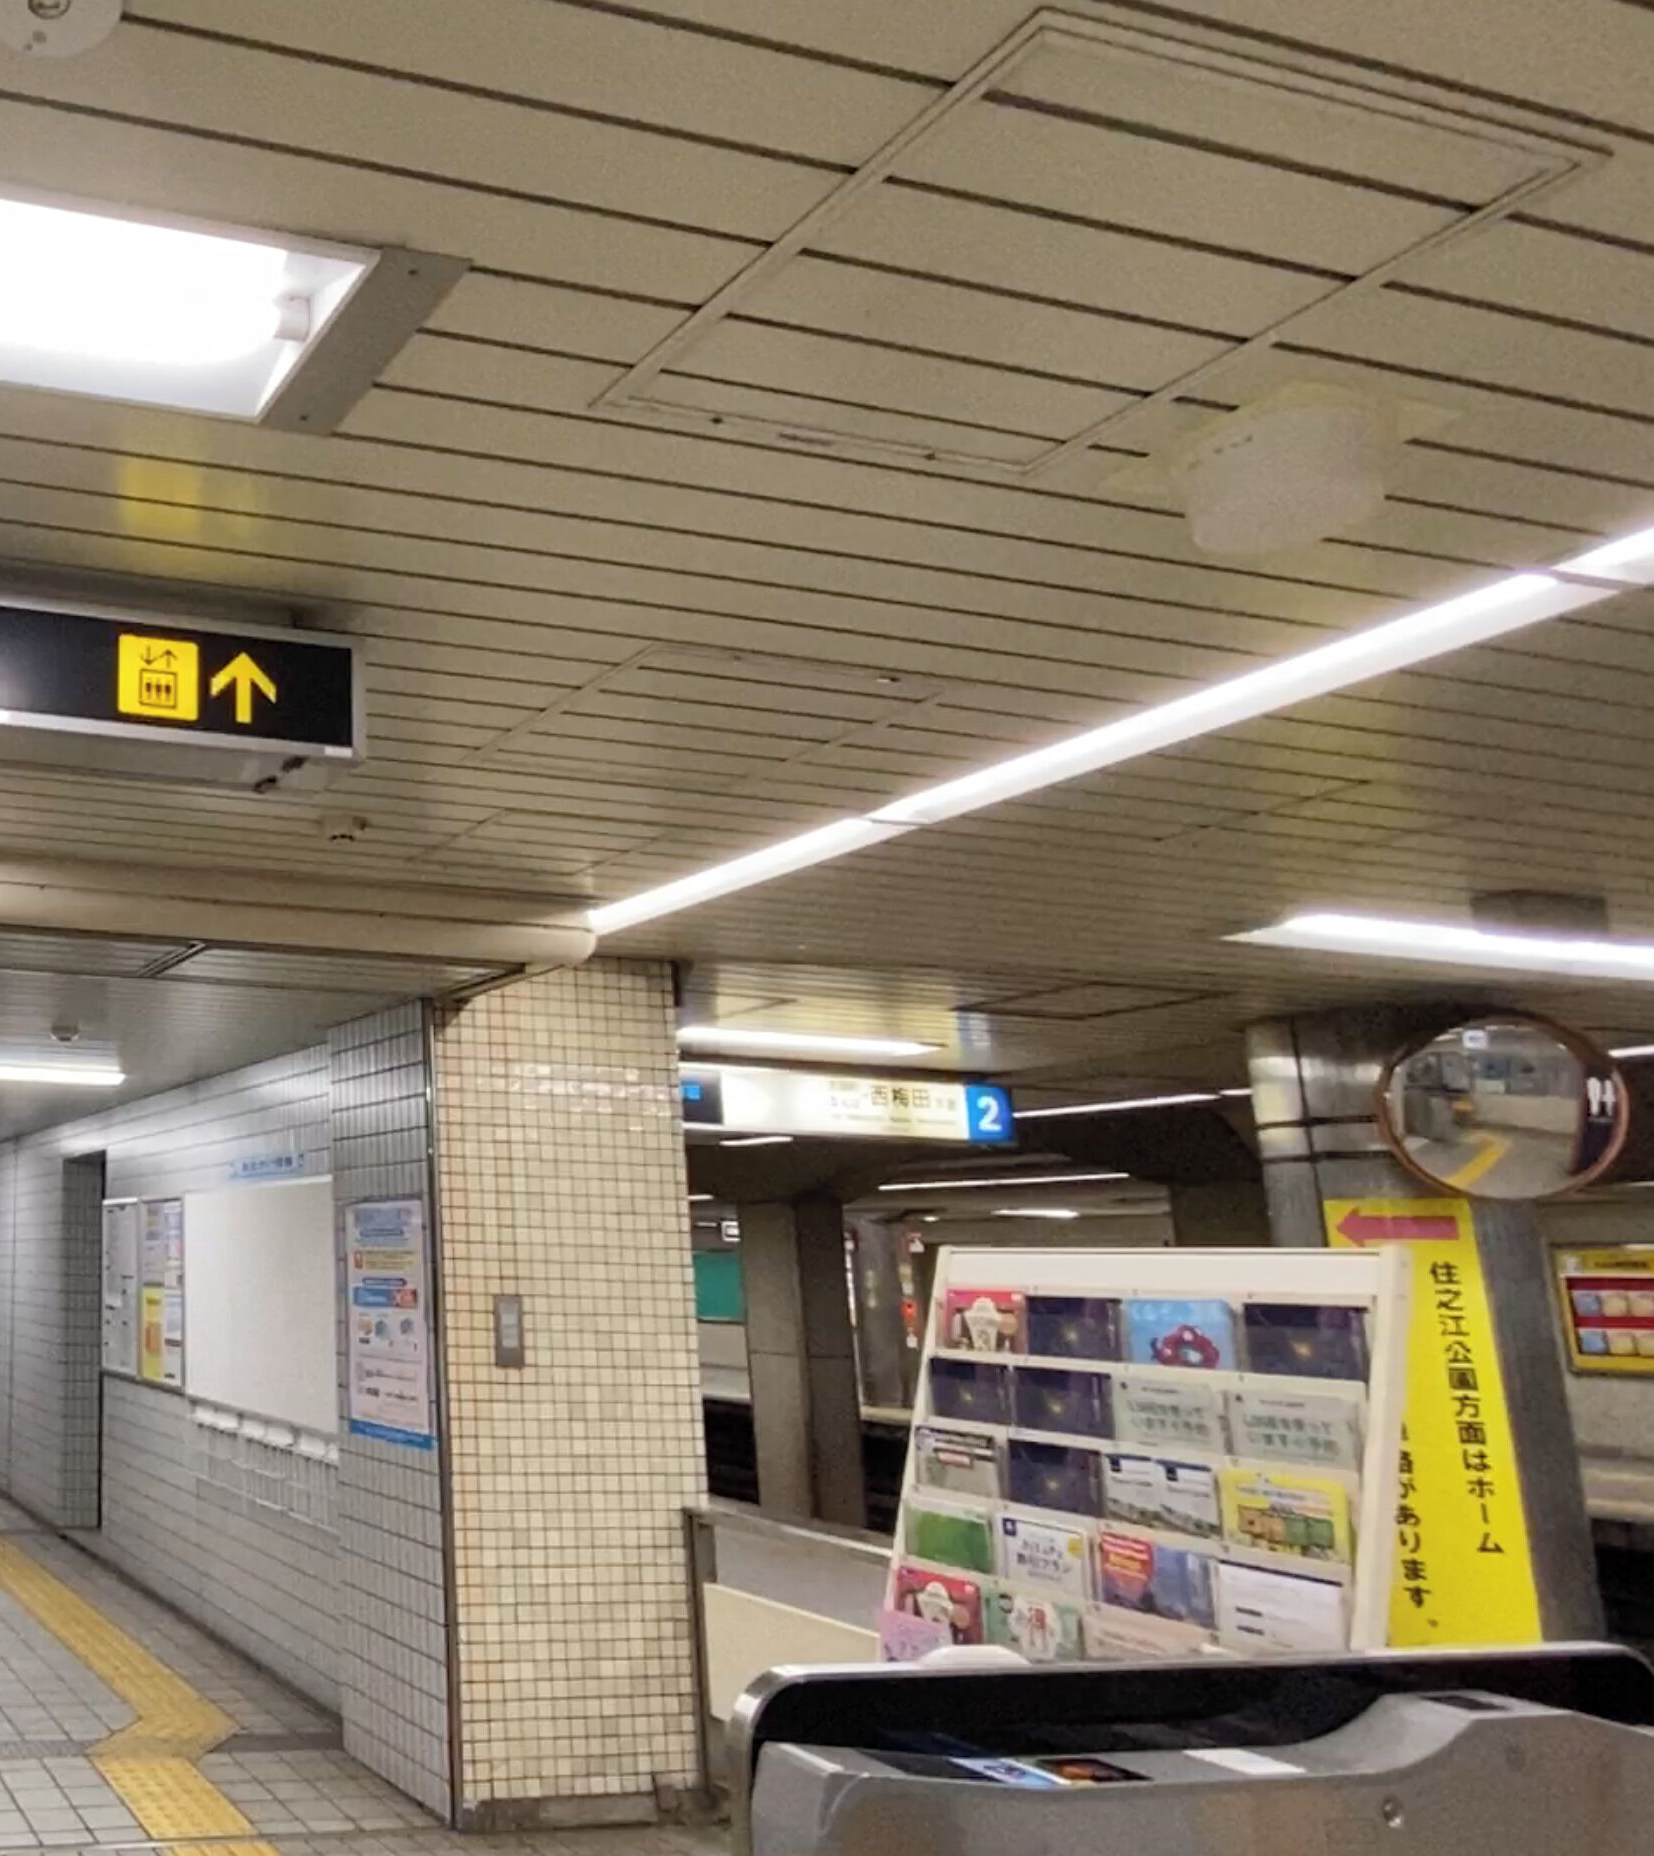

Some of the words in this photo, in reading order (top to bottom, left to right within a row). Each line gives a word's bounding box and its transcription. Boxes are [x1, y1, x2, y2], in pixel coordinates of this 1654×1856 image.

[871, 1084, 931, 1109] 西梅田
[976, 1095, 1003, 1132] 2
[1429, 1261, 1504, 1554] 住之江公園方面はホーム
